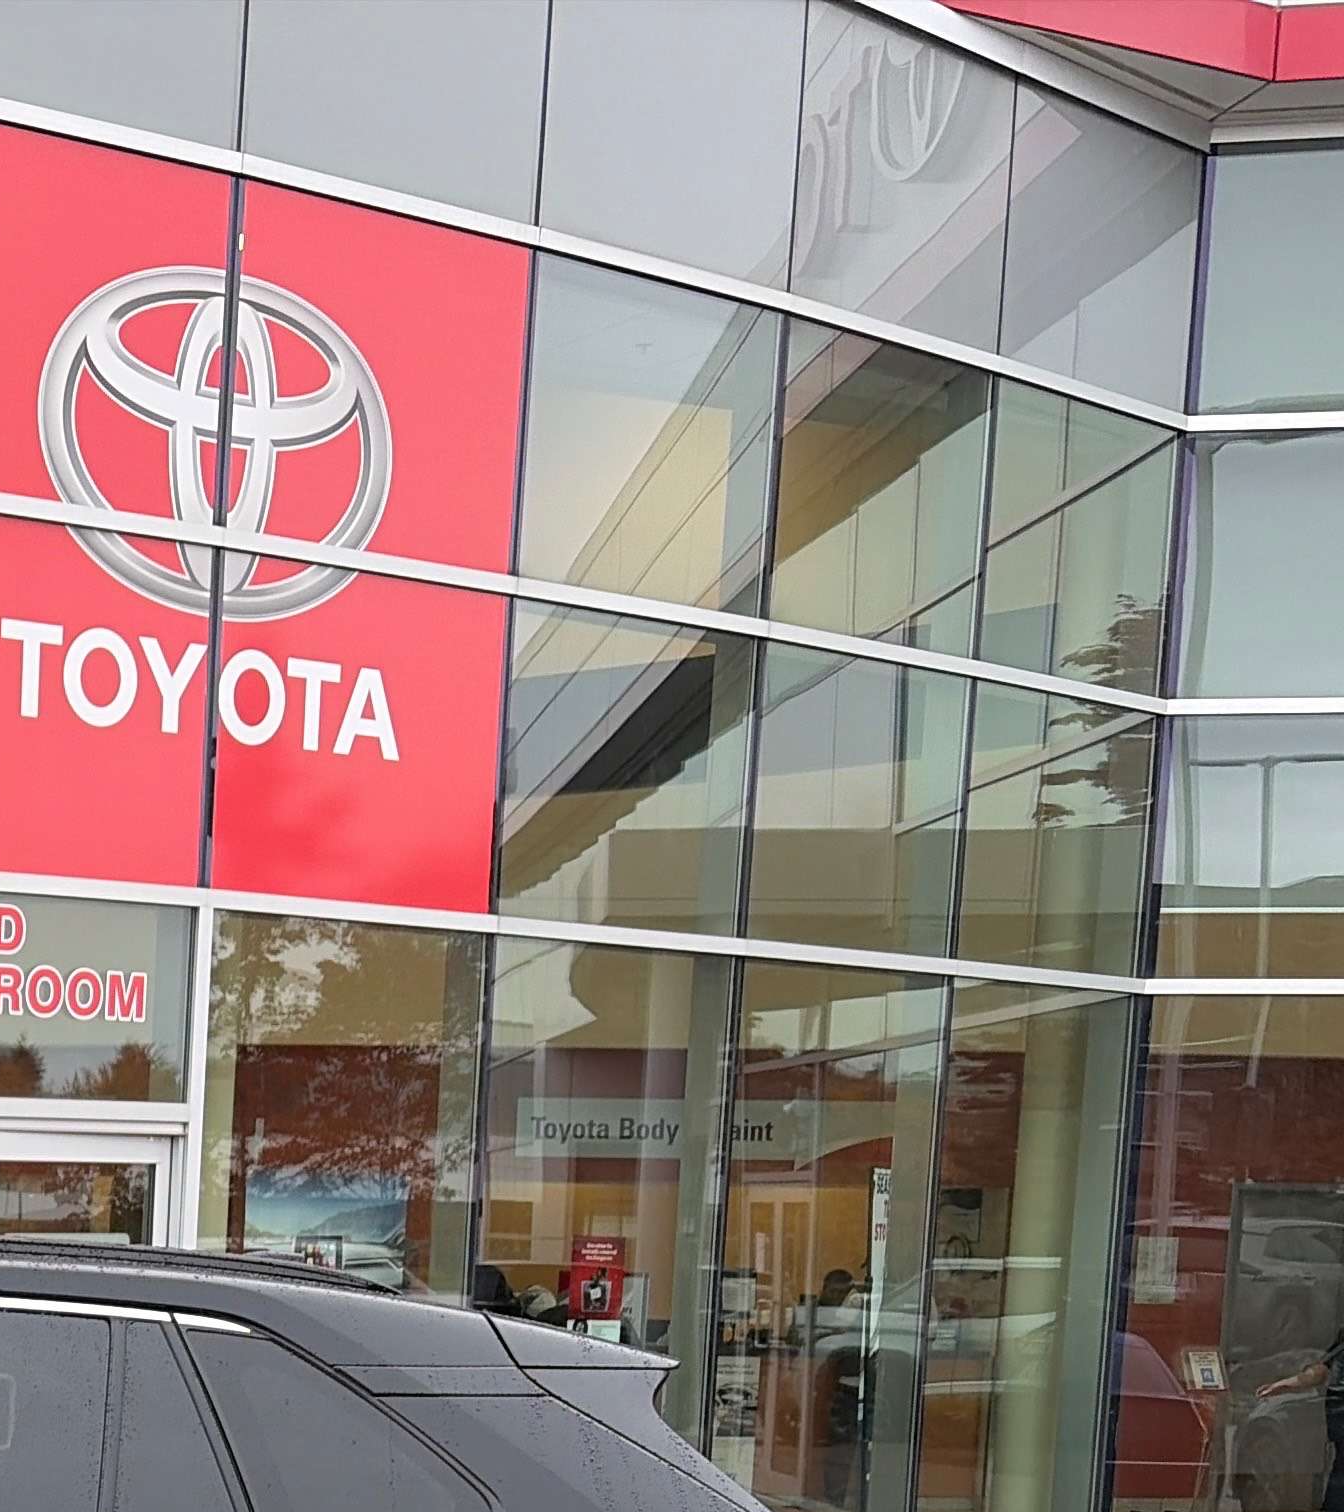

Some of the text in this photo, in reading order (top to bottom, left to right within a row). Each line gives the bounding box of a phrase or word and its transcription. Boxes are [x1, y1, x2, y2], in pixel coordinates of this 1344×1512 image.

[0, 617, 400, 762] TOYOTA
[530, 1116, 774, 1145] Toyota Body aint
